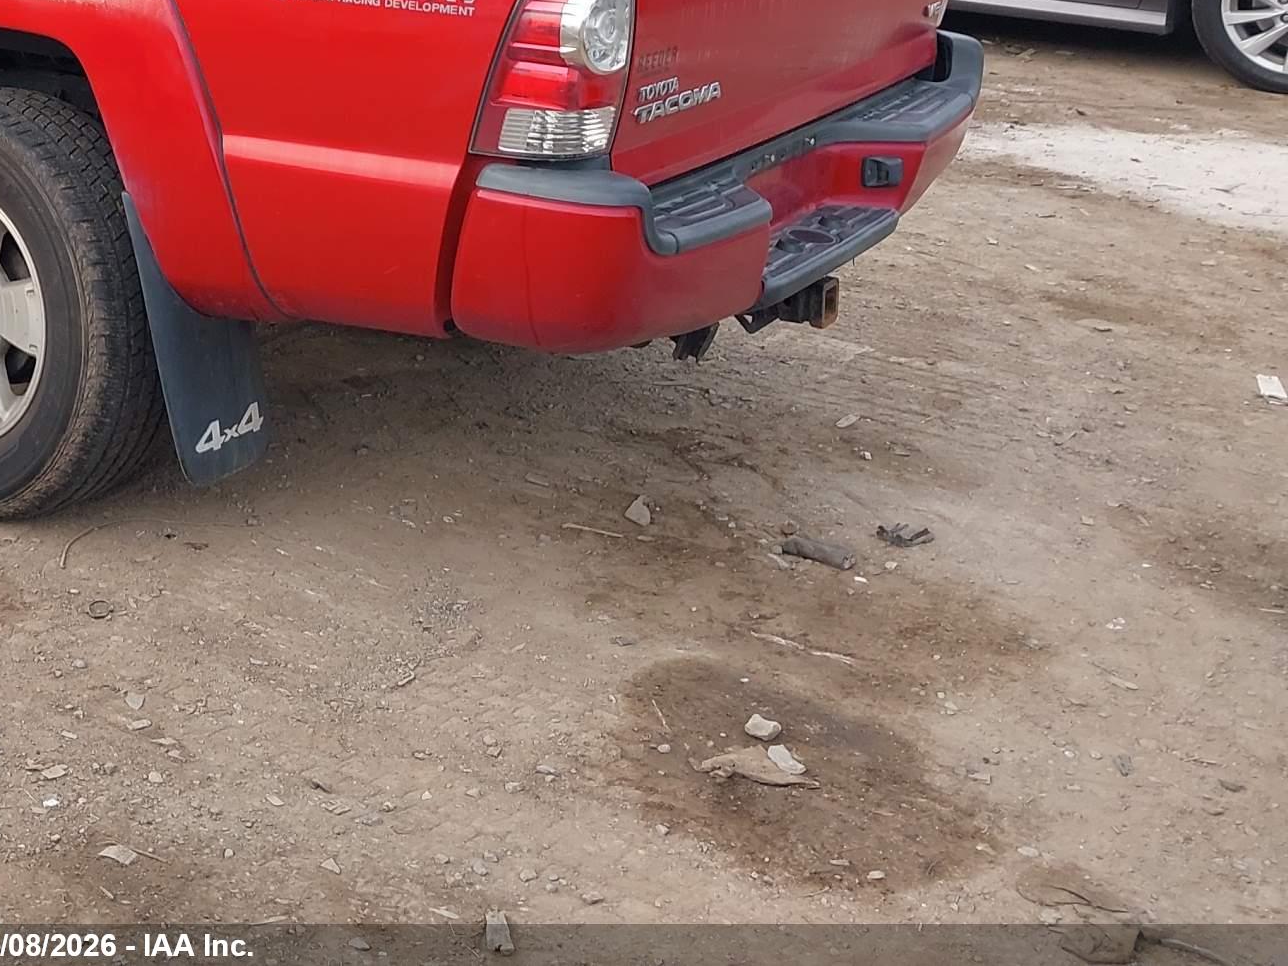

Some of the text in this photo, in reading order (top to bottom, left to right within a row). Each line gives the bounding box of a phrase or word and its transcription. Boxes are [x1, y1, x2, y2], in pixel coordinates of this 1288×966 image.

[632, 82, 721, 125] TACOMA
[639, 76, 679, 102] TOYOTA
[195, 401, 265, 454] 4x4
